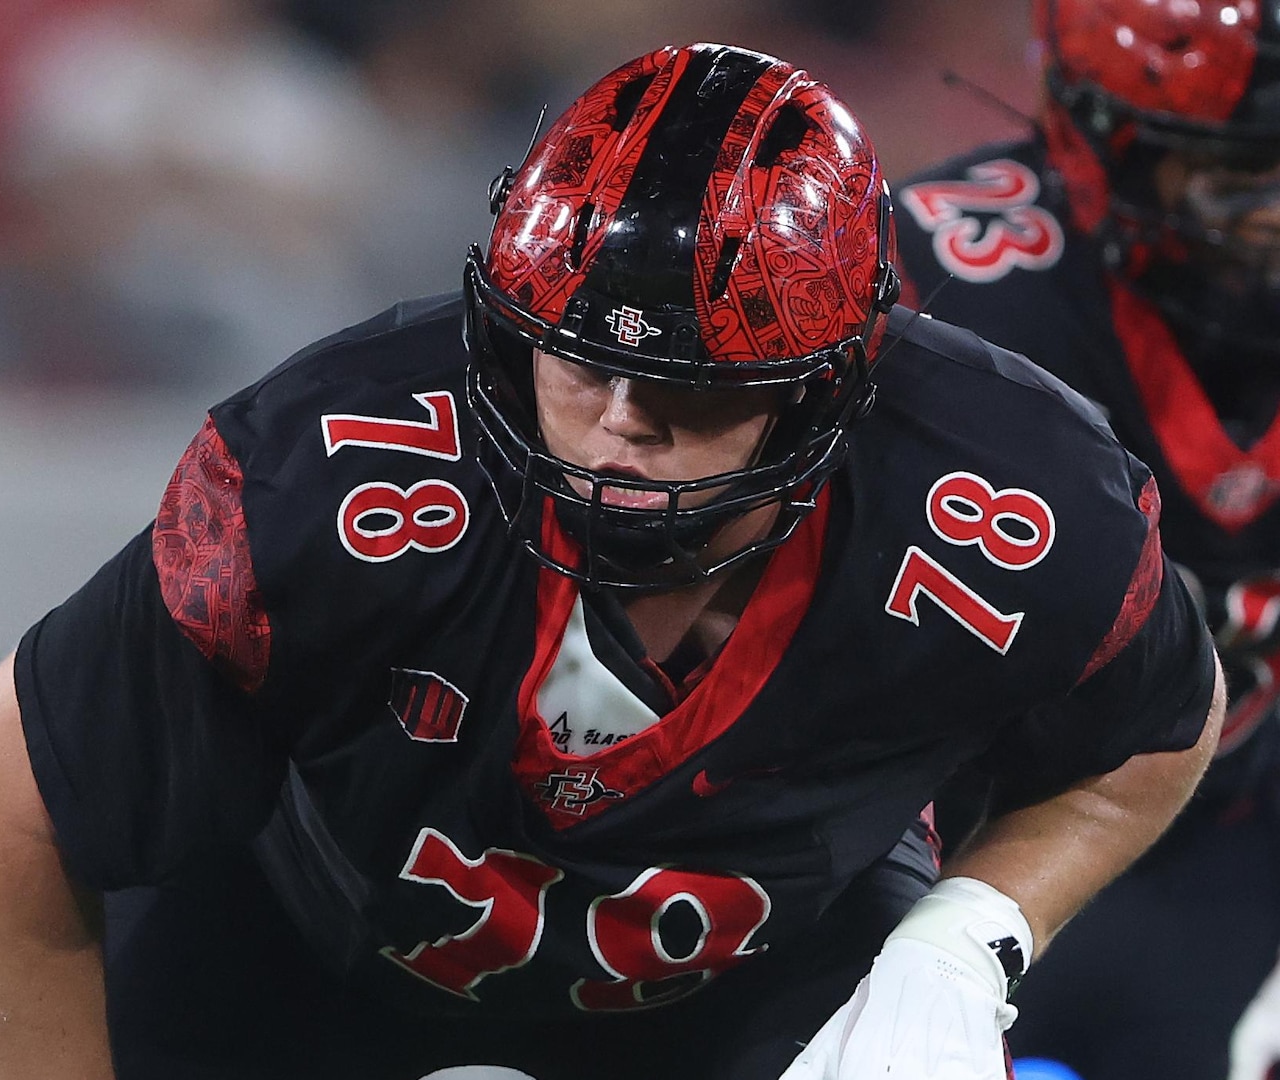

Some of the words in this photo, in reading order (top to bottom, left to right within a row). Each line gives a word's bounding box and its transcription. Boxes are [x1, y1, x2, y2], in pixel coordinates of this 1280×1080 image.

[901, 158, 1064, 284] 23
[322, 390, 470, 563] 78
[885, 471, 1057, 655] 78
[378, 826, 772, 1012] 78
